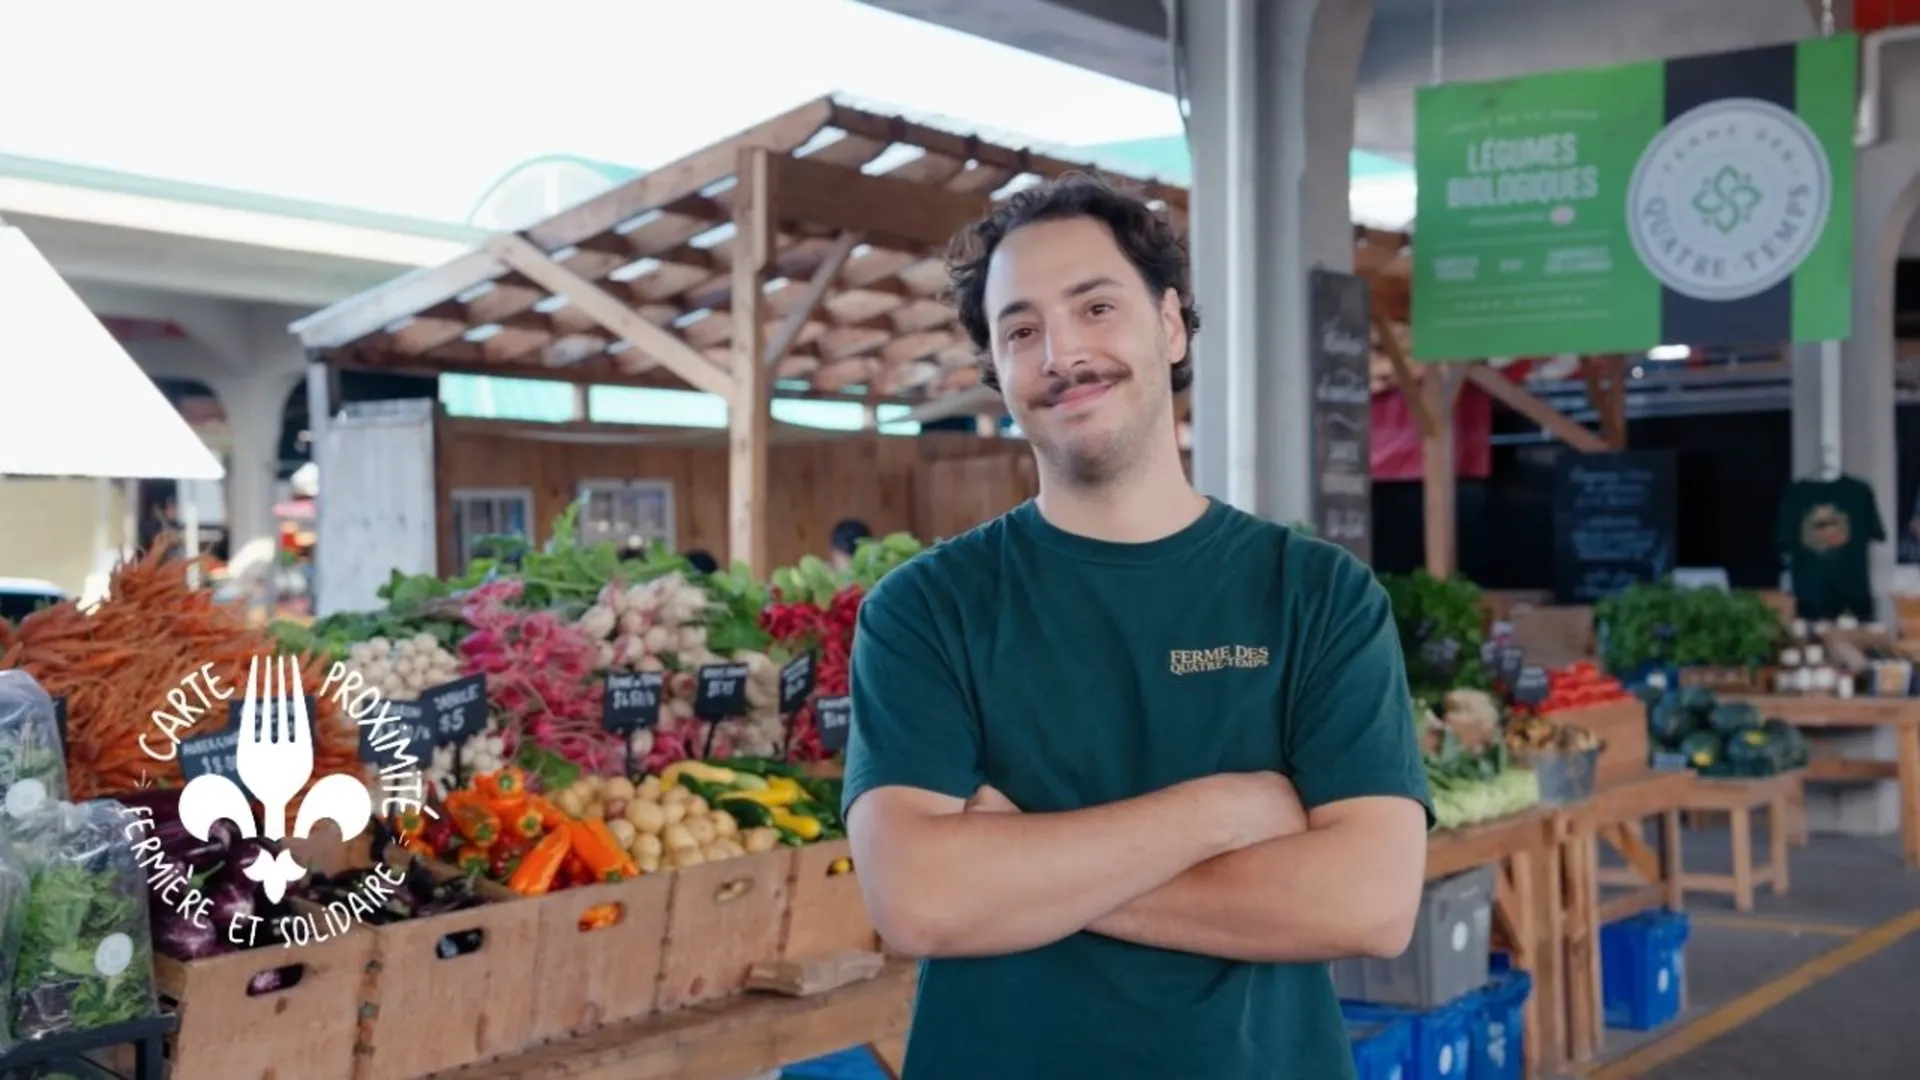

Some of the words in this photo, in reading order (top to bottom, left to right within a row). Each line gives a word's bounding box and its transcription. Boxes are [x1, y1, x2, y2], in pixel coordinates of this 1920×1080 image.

[1466, 130, 1578, 174] LÉGUMES
[1446, 164, 1599, 210] BIOLOGIQUES
[1170, 645, 1232, 665] FERME
[1235, 644, 1269, 661] DES
